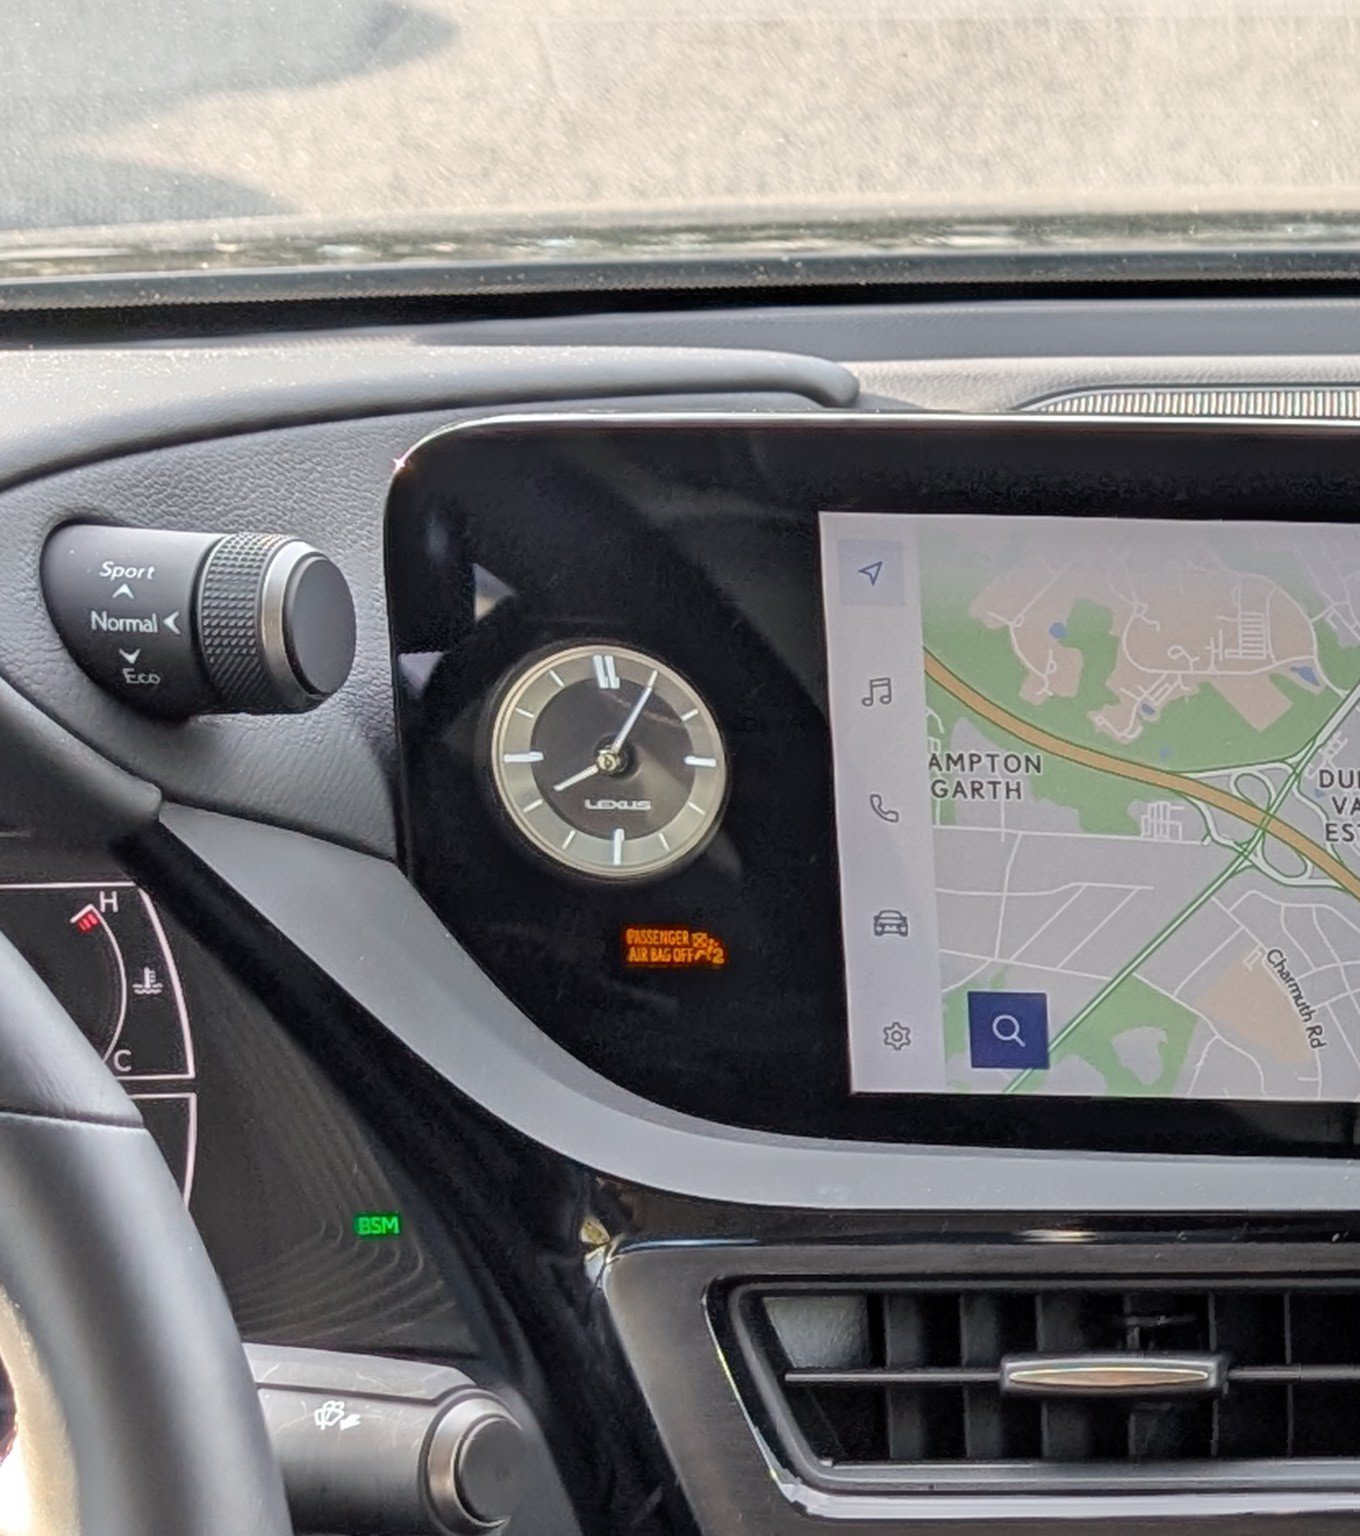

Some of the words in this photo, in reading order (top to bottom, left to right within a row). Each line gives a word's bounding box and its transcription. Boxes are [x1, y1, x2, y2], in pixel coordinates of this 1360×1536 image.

[100, 560, 154, 581] Sport
[91, 611, 158, 634] Normal
[122, 667, 161, 685] Eco
[931, 780, 1021, 799] GARTH
[584, 799, 651, 811] LEXUS
[100, 890, 118, 912] H
[626, 929, 689, 945] PASSENGER
[628, 946, 648, 962] AIR
[650, 948, 671, 962] BAG
[673, 948, 693, 962] OFF
[1267, 949, 1316, 1022] Charmuth
[1306, 1025, 1327, 1049] Rd
[113, 1049, 132, 1072] C
[358, 1216, 399, 1234] BSM
